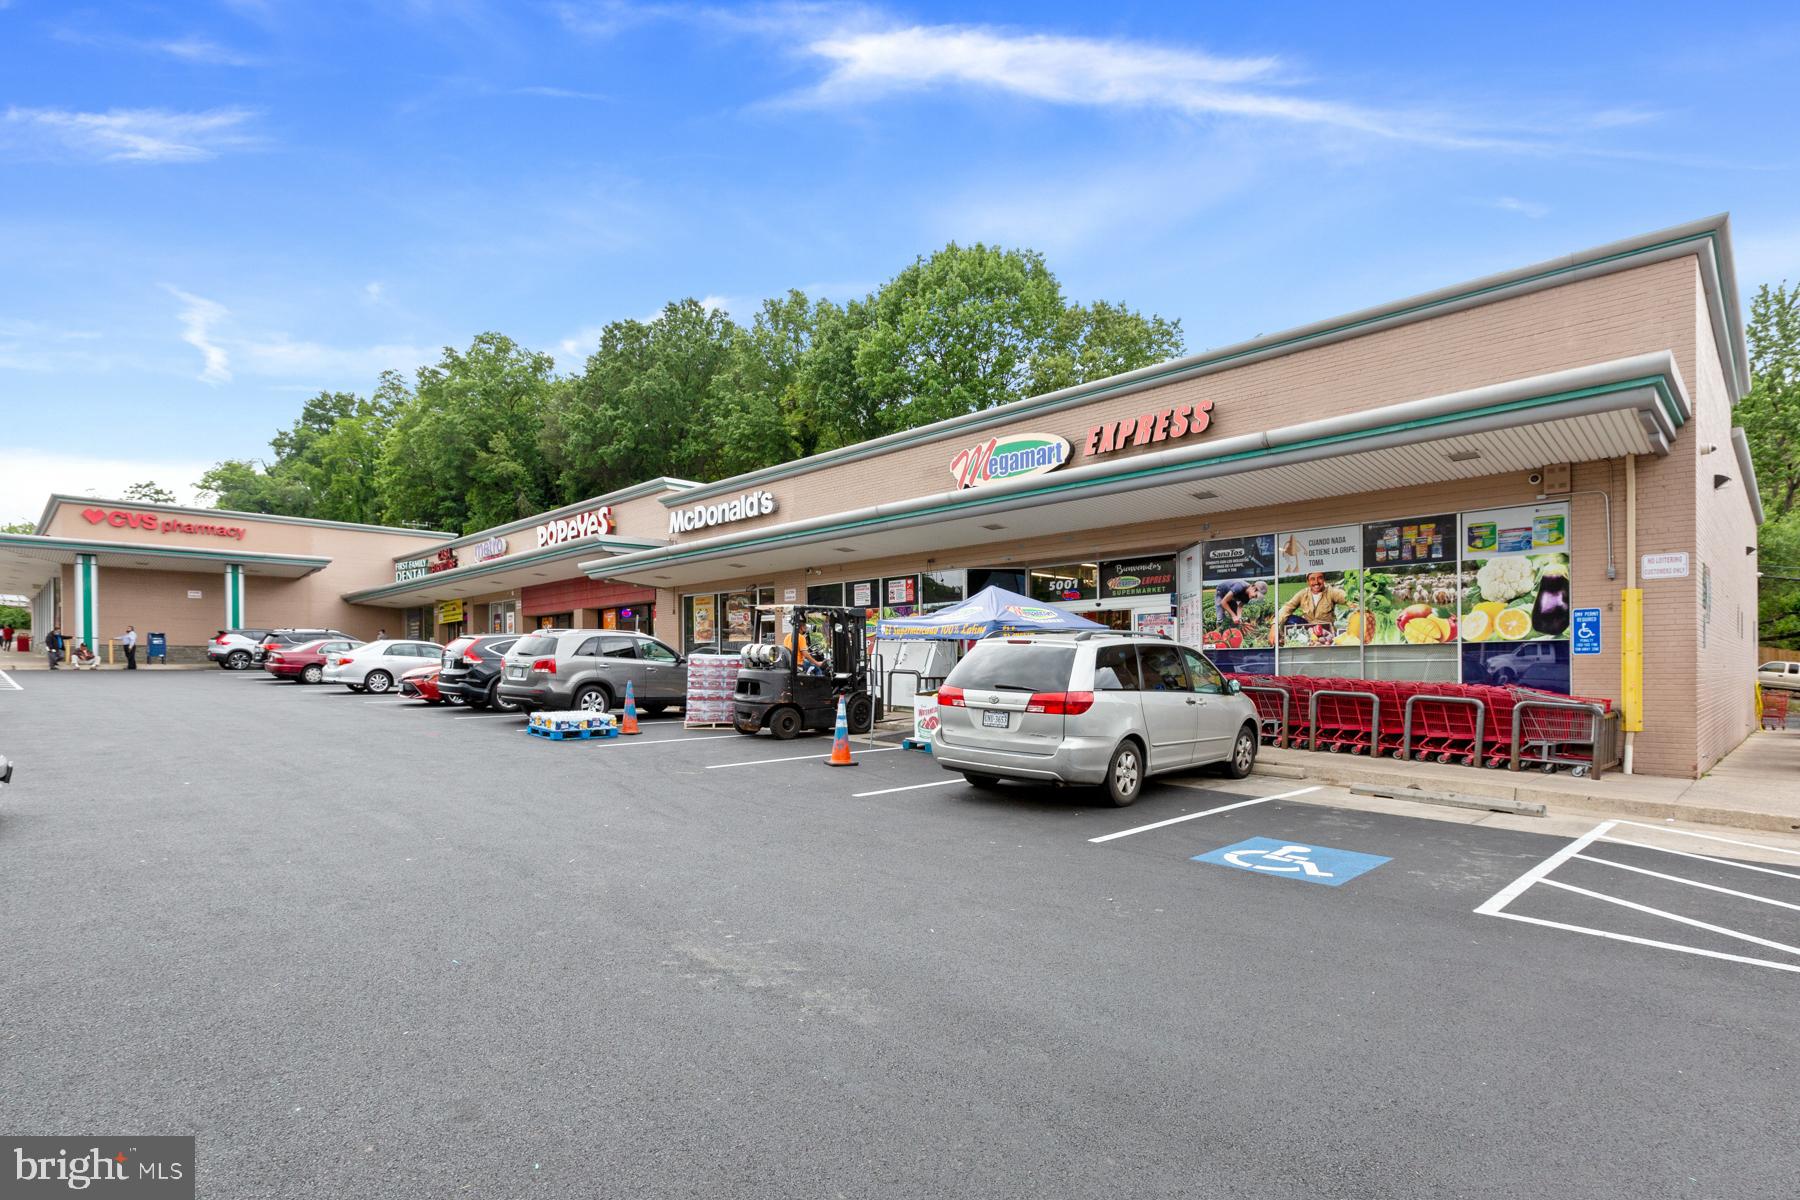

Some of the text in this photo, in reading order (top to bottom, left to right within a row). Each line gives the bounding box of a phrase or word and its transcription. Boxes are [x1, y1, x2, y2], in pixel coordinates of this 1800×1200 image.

[1084, 400, 1214, 457] EXPRESS
[951, 437, 1063, 490] Megamart
[668, 491, 774, 534] McDonald's
[107, 510, 247, 540] CVS pharmacy
[1308, 536, 1346, 546] CUANDO NADA
[475, 537, 503, 558] metro
[1308, 547, 1331, 556] DETIENE
[1331, 547, 1340, 555] LA
[1211, 549, 1243, 559] SanaTos
[395, 560, 408, 571] FIRST
[409, 559, 428, 570] FAMILY
[1116, 562, 1162, 574] Bienvenidos
[395, 569, 426, 582] DENTAL
[1141, 574, 1172, 586] EXPRESS
[1049, 579, 1079, 591] 5001
[1112, 586, 1167, 597] SUPERMARKET
[940, 625, 960, 635] 100%
